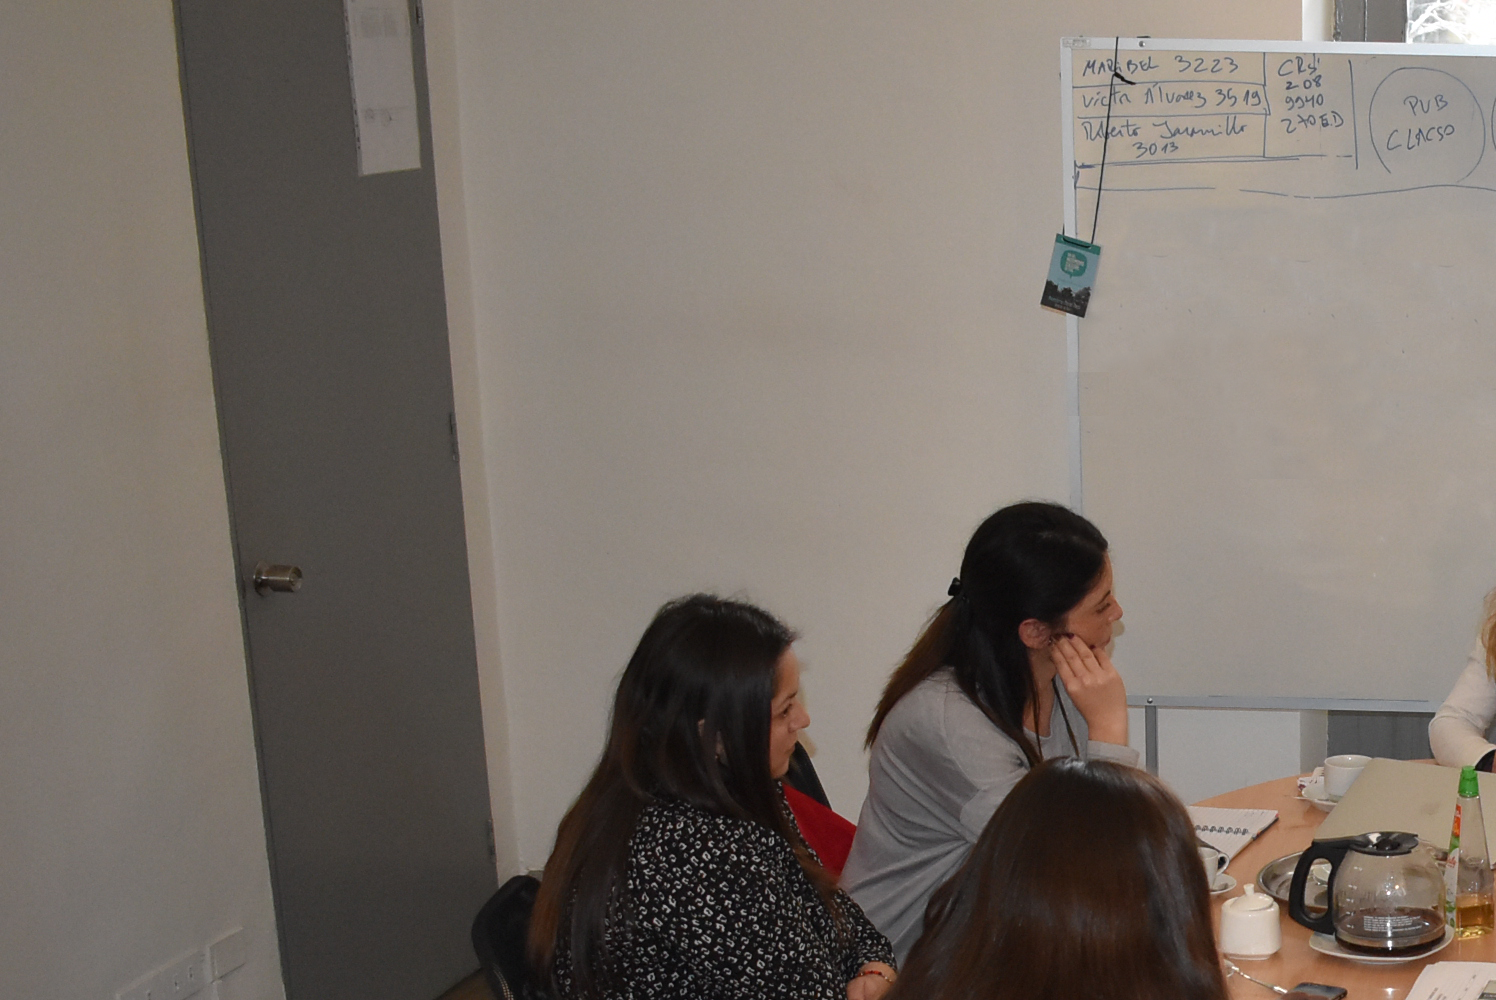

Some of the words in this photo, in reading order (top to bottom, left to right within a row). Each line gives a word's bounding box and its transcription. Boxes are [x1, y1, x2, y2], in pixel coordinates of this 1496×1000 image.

[1175, 54, 1239, 73] 3223
[1402, 95, 1449, 117] PUB
[1386, 124, 1456, 151] CLACSO
